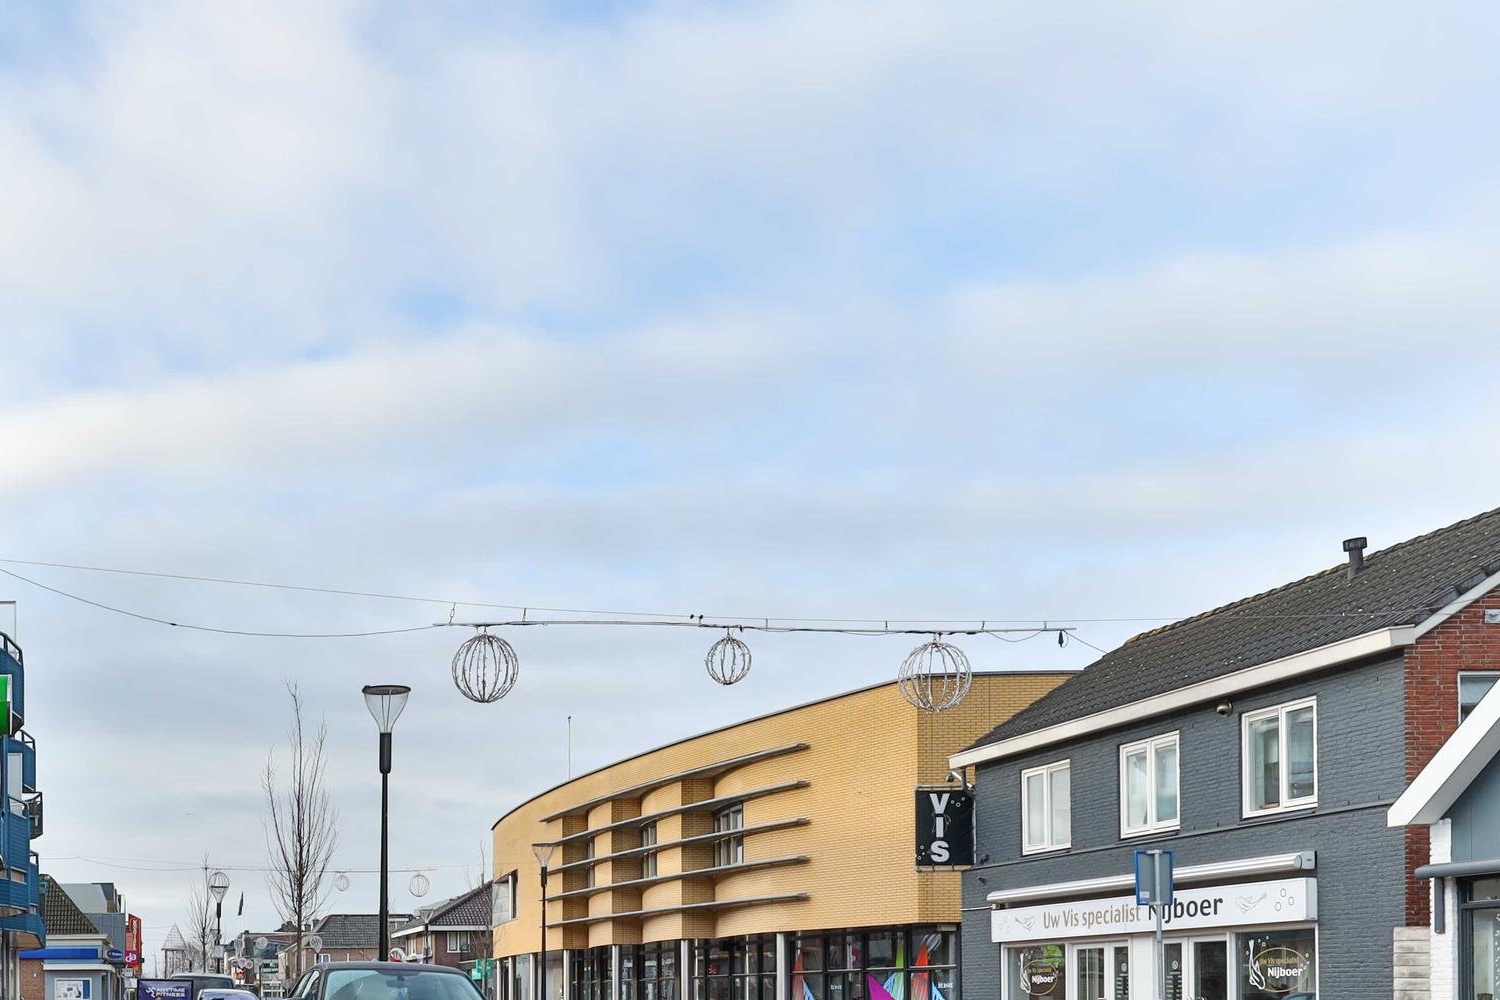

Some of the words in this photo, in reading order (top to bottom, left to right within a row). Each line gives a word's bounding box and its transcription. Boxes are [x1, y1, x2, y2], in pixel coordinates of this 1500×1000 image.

[929, 793, 950, 863] VIS
[1043, 911, 1061, 929] Uw
[1063, 908, 1079, 927] Vis
[1081, 903, 1141, 930] specialist
[1031, 975, 1055, 985] Nijboer
[1267, 966, 1303, 979] Nijboer
